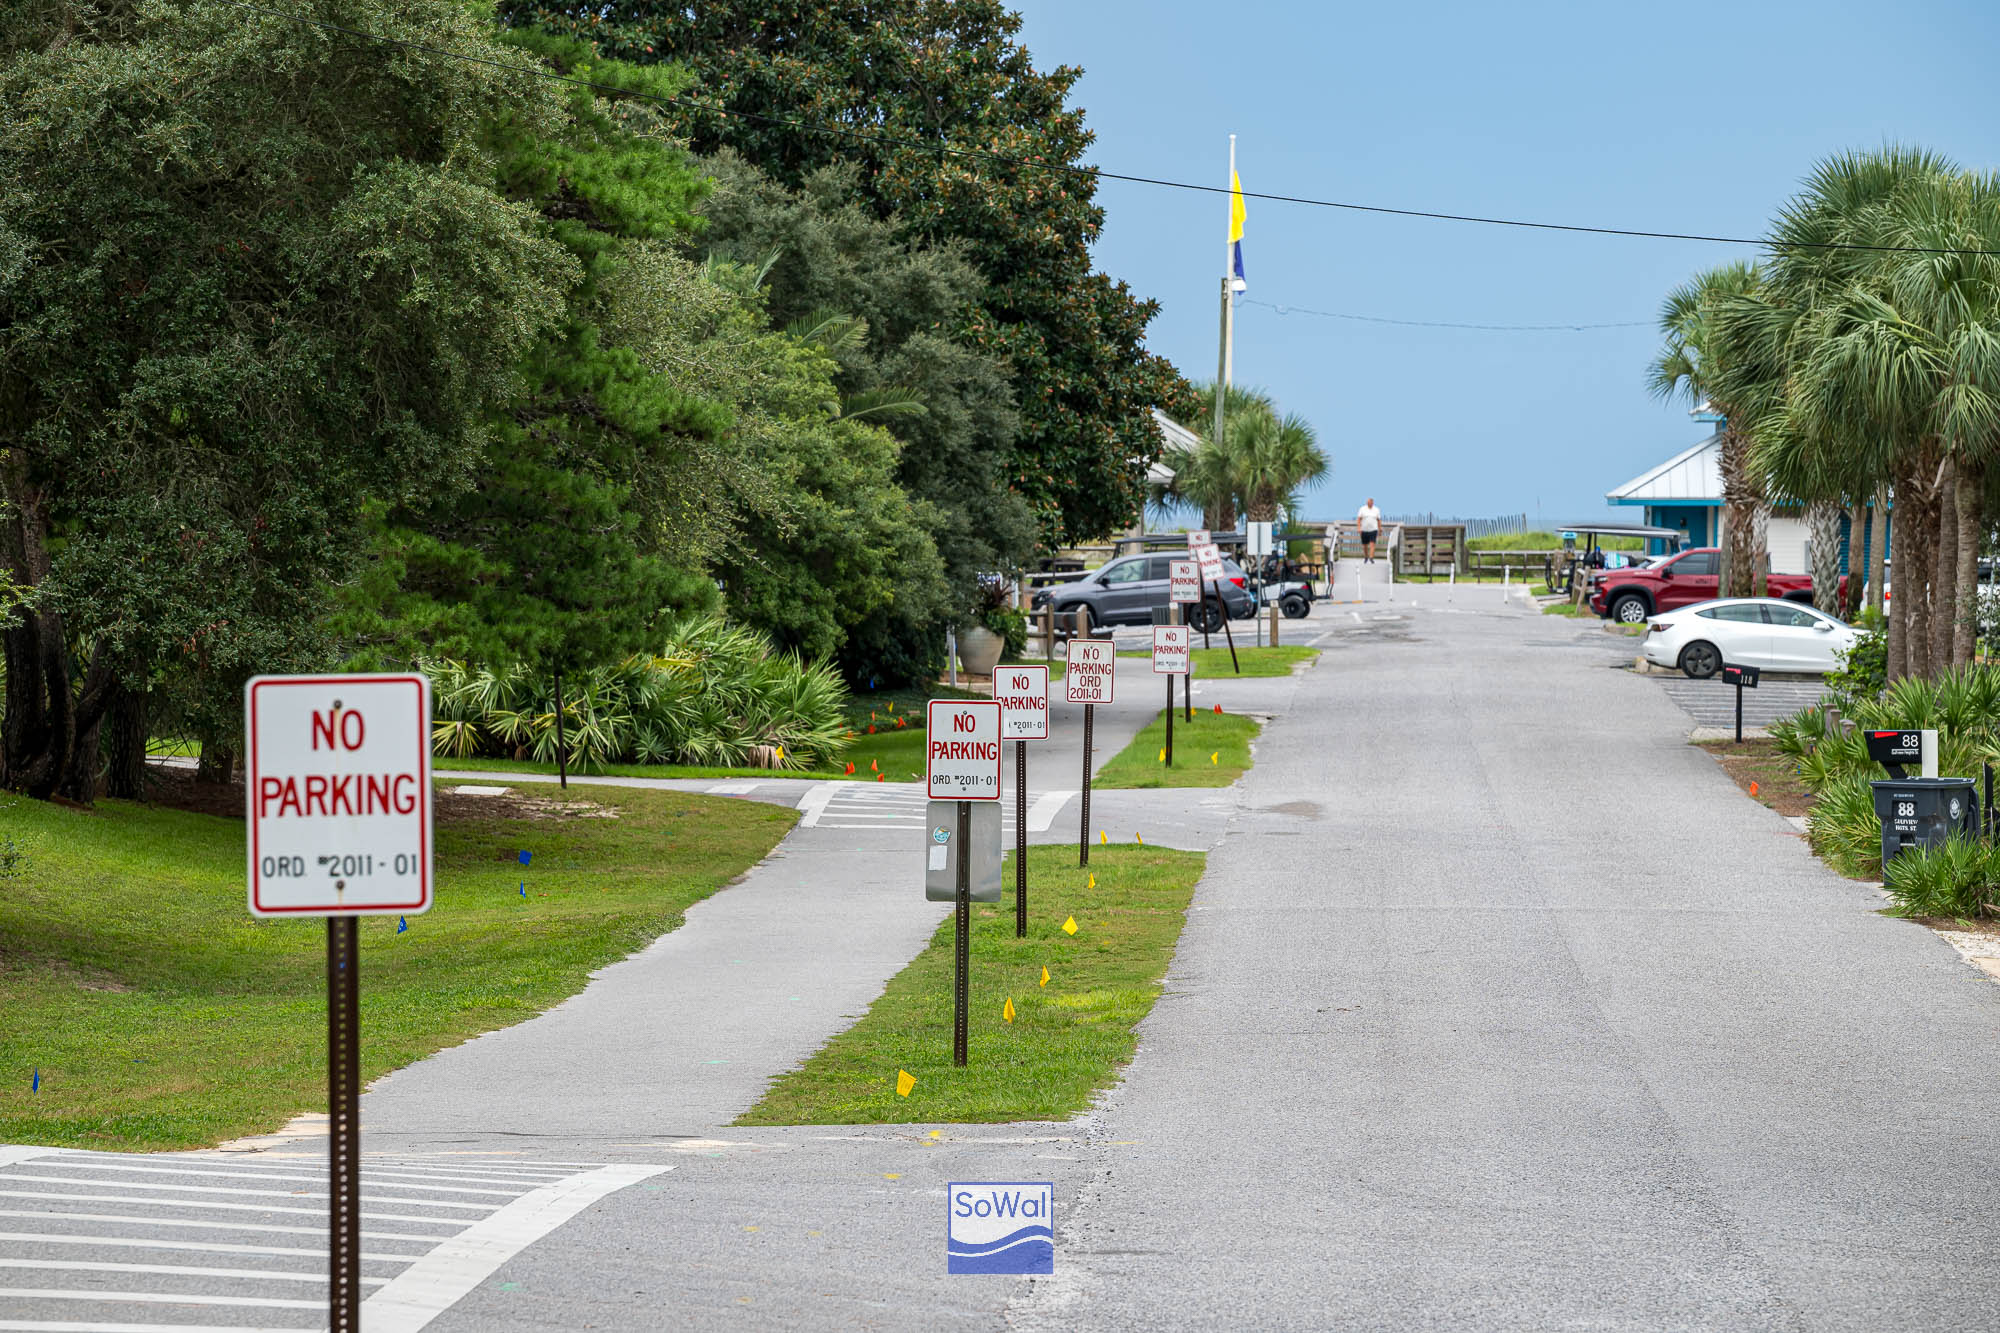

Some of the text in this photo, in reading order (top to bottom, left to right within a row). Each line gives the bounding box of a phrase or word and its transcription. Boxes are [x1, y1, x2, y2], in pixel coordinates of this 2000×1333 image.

[1180, 566, 1190, 574] NO
[1166, 632, 1176, 642] NO
[1083, 648, 1100, 660] NO
[1156, 646, 1186, 655] PARKING
[1070, 663, 1112, 675] PARKING
[1012, 676, 1030, 690] NO
[1080, 676, 1101, 688] ORD
[954, 714, 976, 733] NO
[312, 710, 364, 752] NO
[1902, 735, 1918, 747] 88
[932, 741, 997, 761] PARKING
[260, 774, 416, 818] PARKING
[1898, 802, 1914, 816] 88
